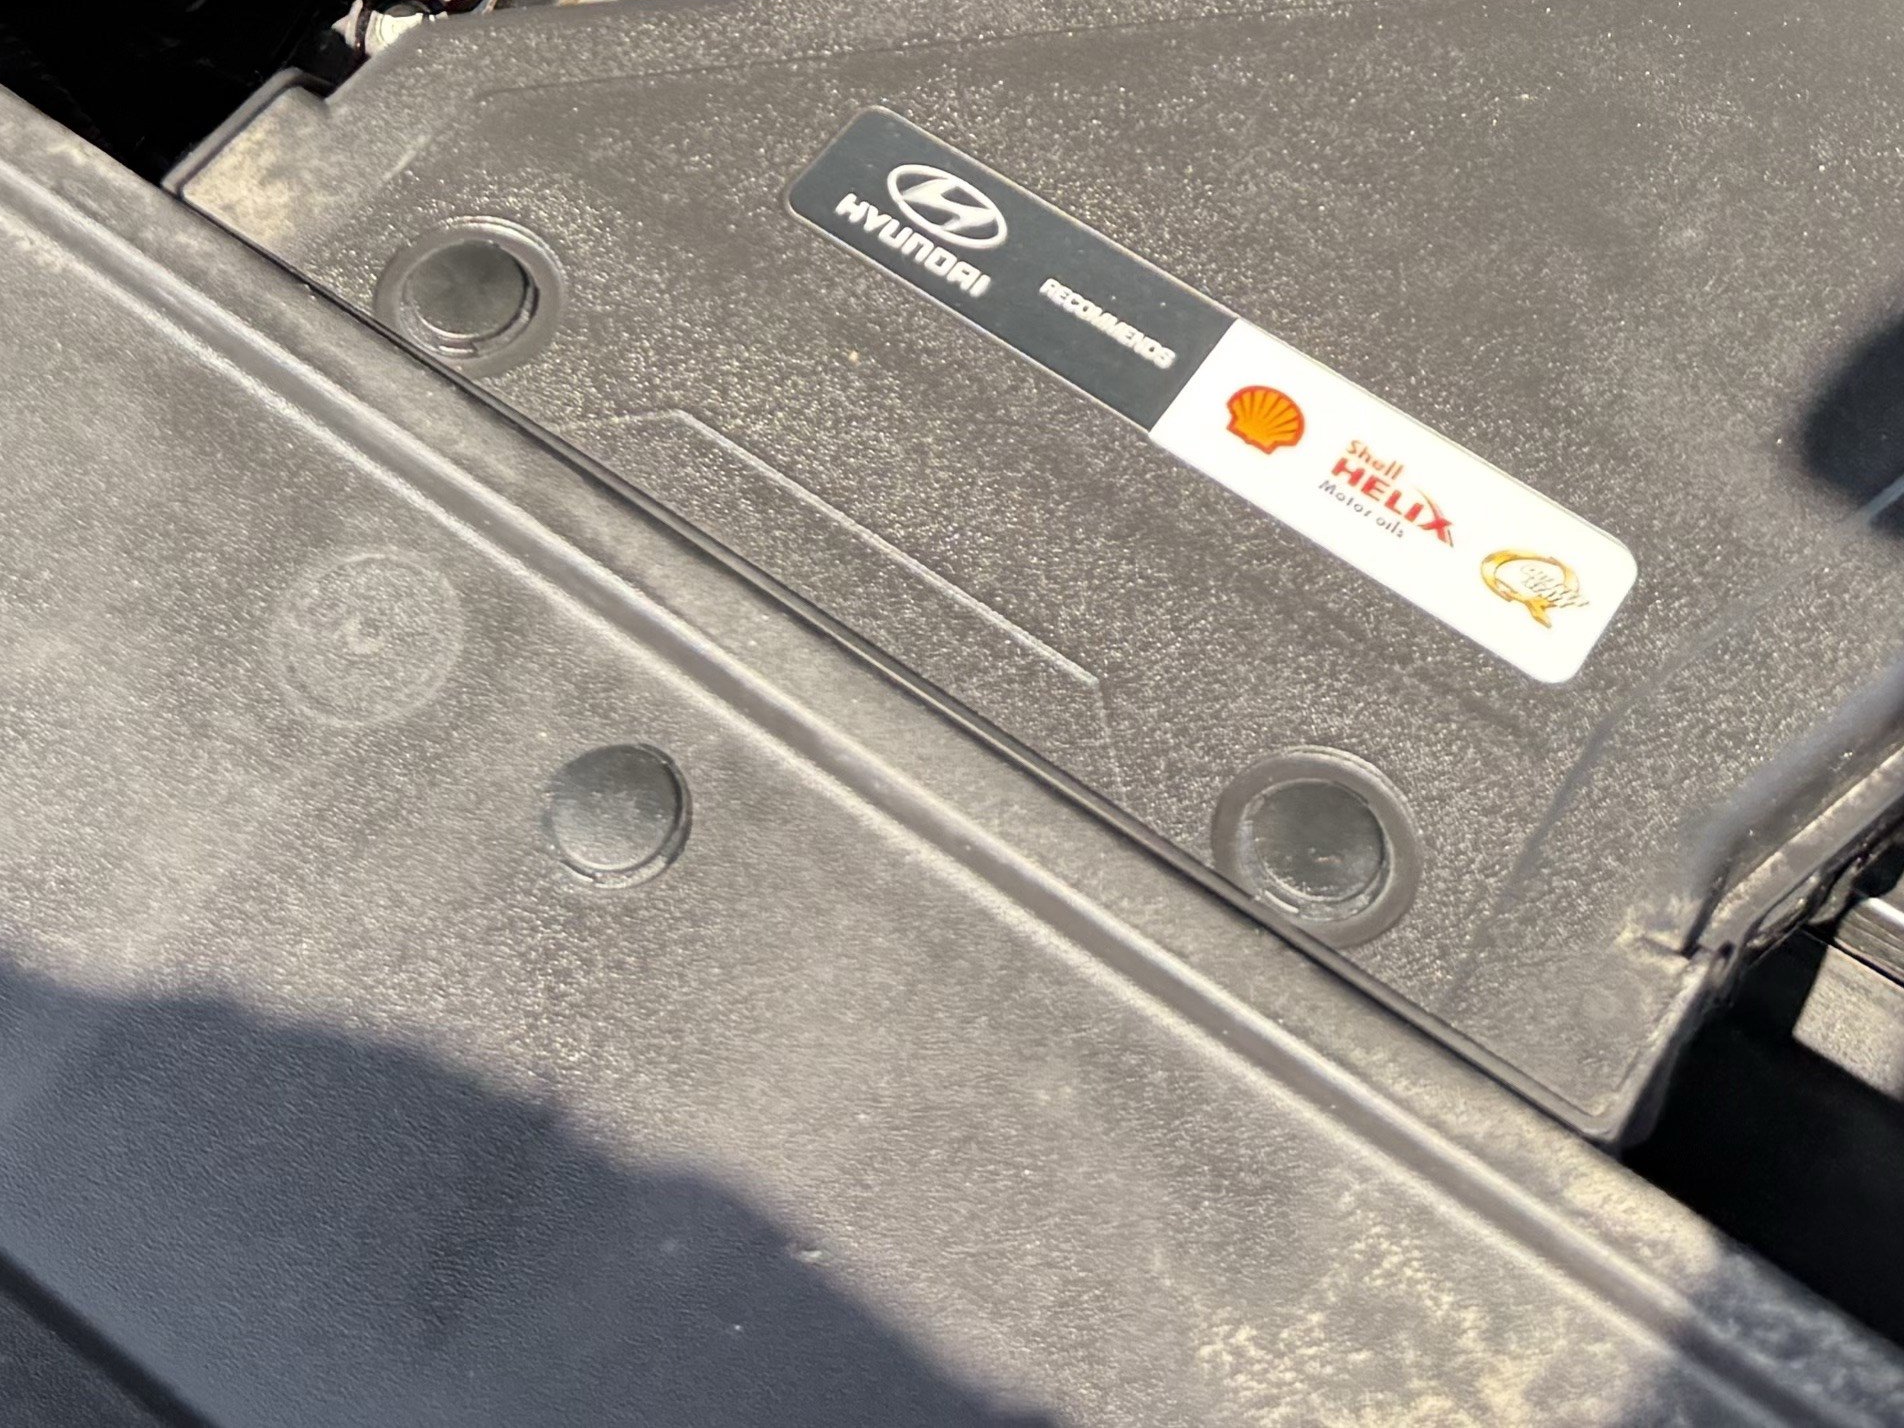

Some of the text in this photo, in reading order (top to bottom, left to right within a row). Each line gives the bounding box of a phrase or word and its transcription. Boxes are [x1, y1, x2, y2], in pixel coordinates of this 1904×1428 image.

[834, 191, 993, 298] HYUNDAI
[1038, 277, 1178, 370] RECOMMENDS
[1330, 457, 1454, 548] HELIX
[1345, 439, 1405, 481] Shell
[1318, 479, 1405, 540] Motor oils
